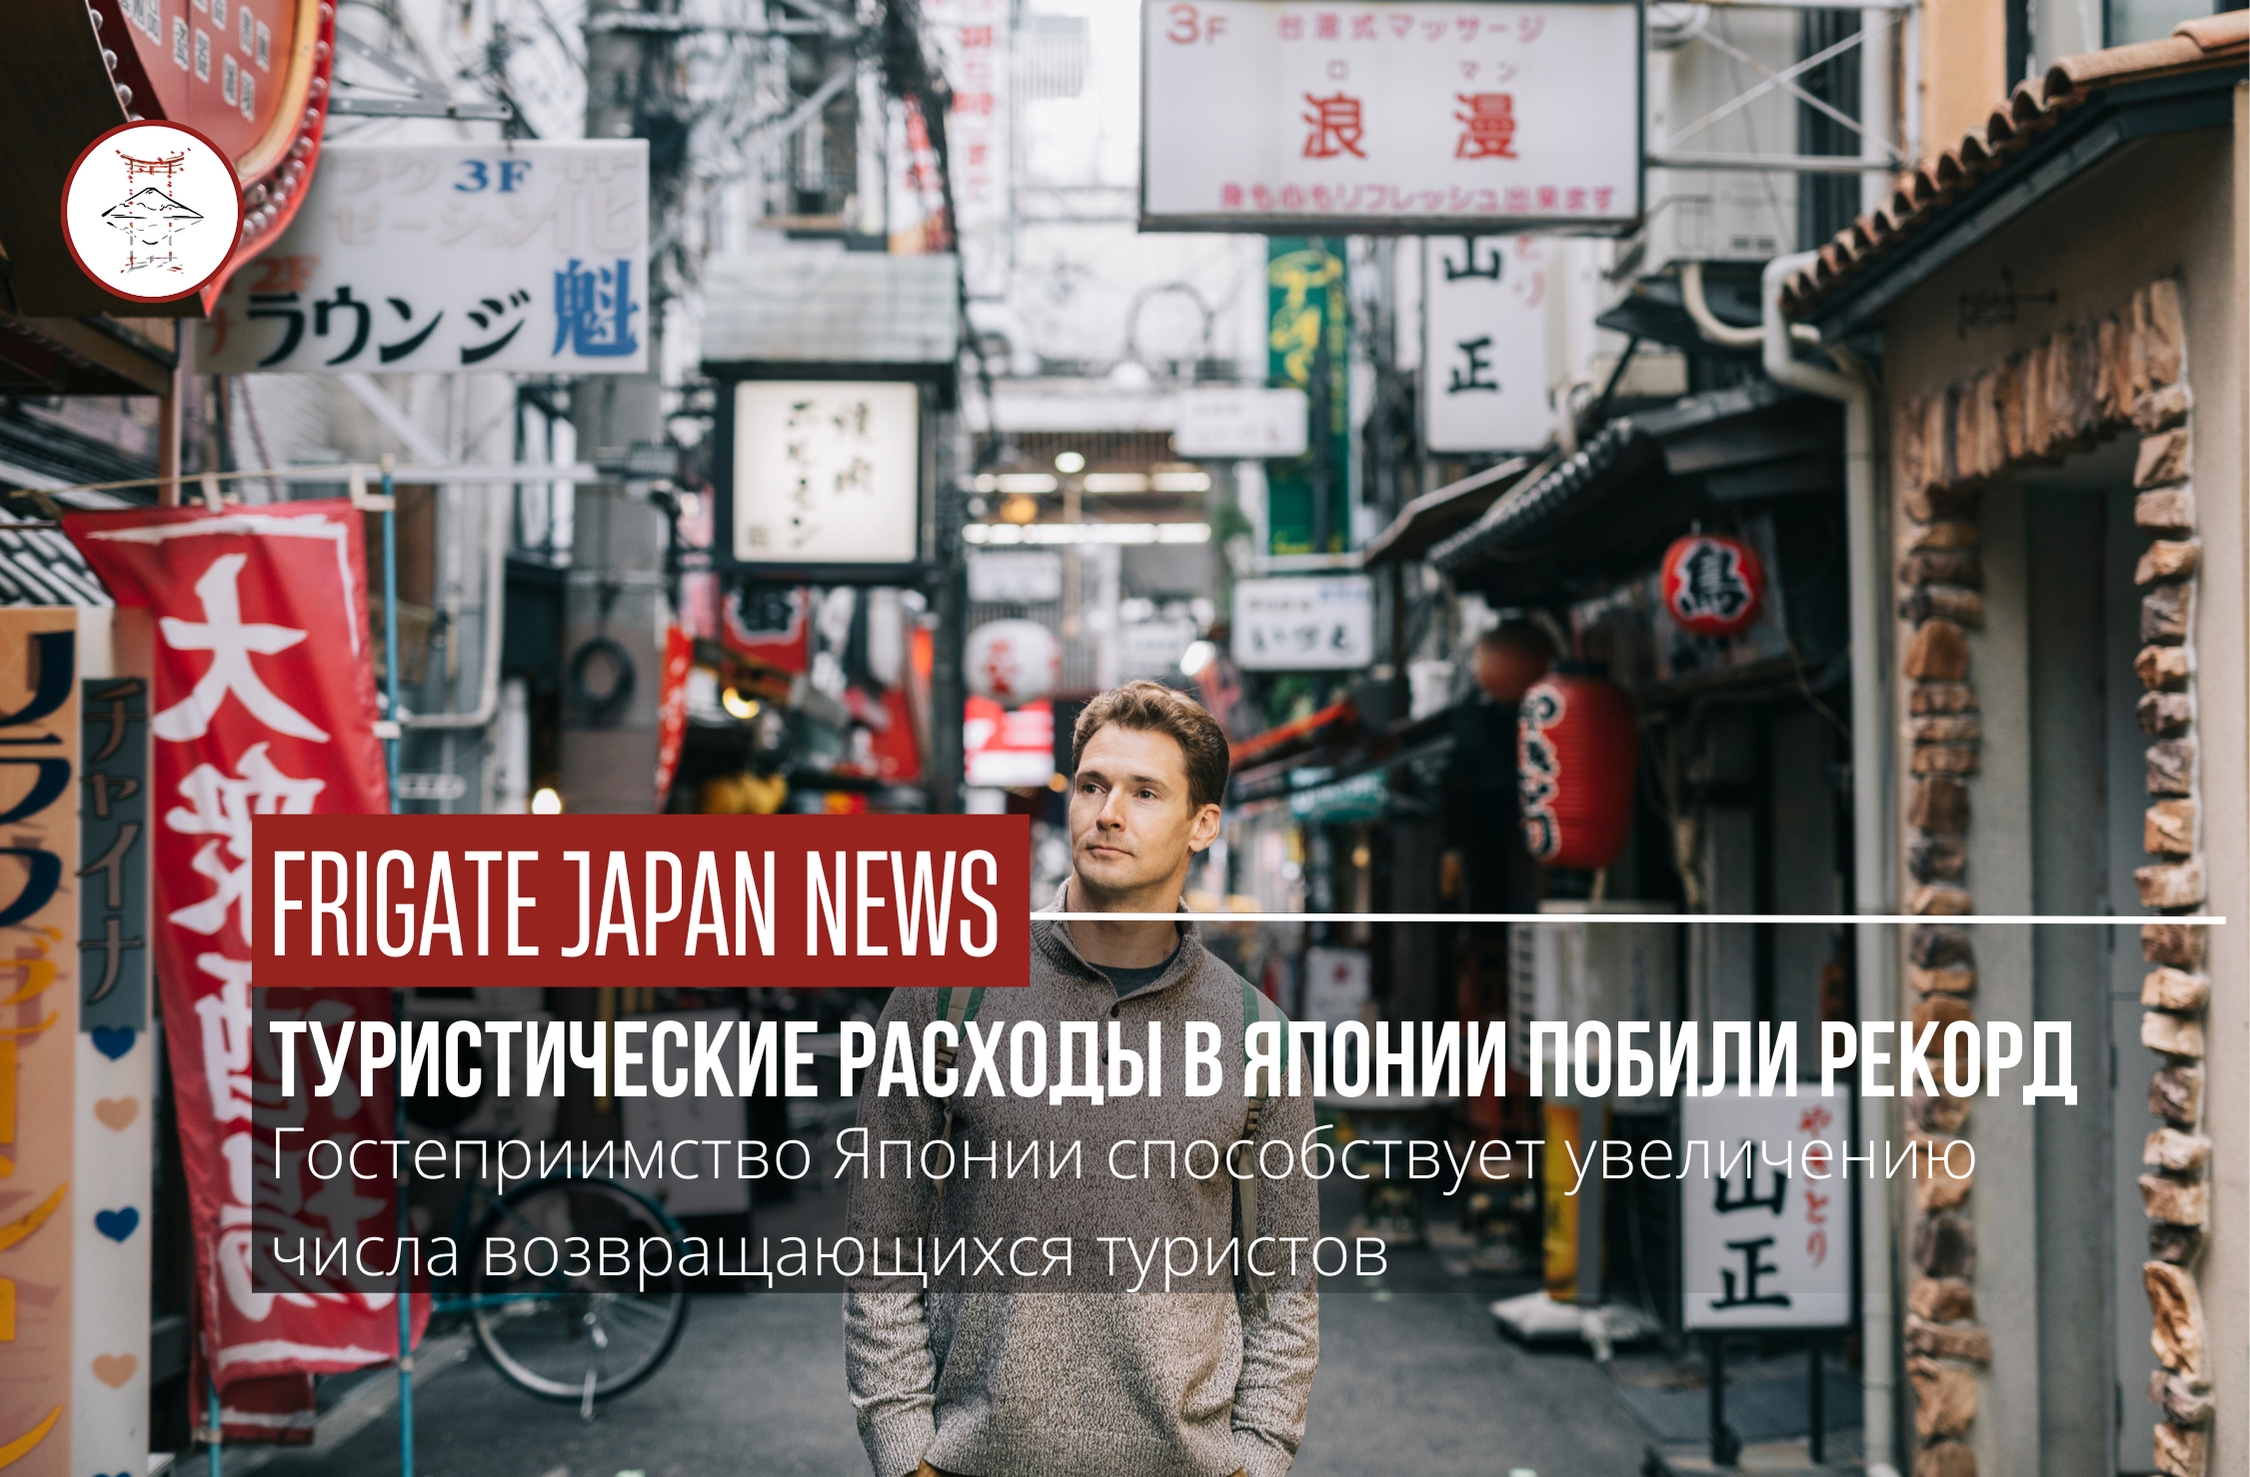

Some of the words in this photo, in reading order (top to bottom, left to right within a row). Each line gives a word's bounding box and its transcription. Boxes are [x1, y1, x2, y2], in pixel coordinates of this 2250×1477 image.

[1166, 4, 1228, 46] 3F
[454, 159, 532, 193] 3F
[252, 255, 320, 291] 2F
[551, 259, 640, 358] 魁
[248, 286, 531, 368] ラウンジ
[76, 677, 146, 1005] チャイナ
[1710, 1137, 1792, 1313] 山正
